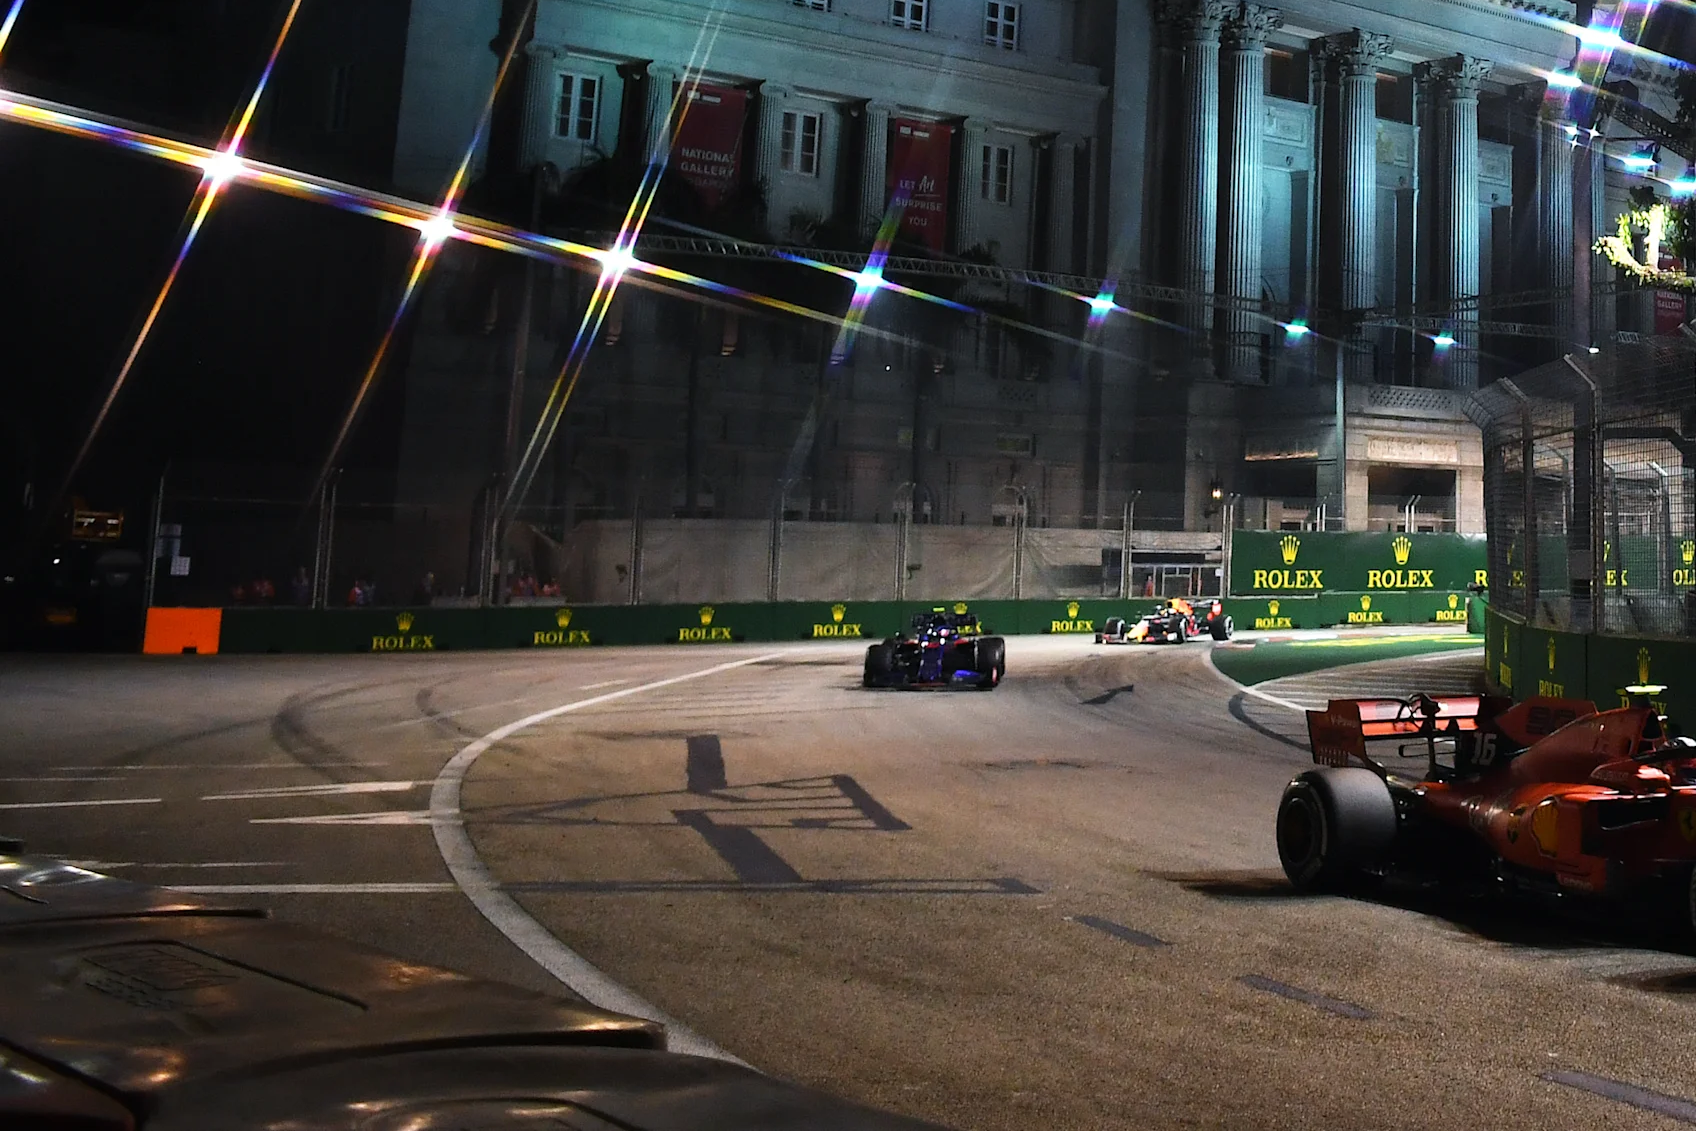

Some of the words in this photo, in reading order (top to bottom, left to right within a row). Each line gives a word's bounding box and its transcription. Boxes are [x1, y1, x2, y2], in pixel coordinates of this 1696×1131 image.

[681, 161, 734, 178] GALLERY
[900, 179, 916, 190] LET
[896, 196, 943, 212] SURPRISE
[908, 216, 928, 227] YOU
[1253, 569, 1324, 589] ROLEX
[1367, 569, 1434, 588] ROLEX
[1255, 617, 1292, 629] ROLEX
[1348, 611, 1384, 623] ROLEX
[679, 626, 732, 641] ROLEX
[813, 623, 862, 638] ROLEX
[1051, 619, 1094, 633] ROLEX
[371, 634, 434, 651] ROLEX
[533, 630, 591, 646] ROLEX
[1470, 731, 1498, 767] 16
